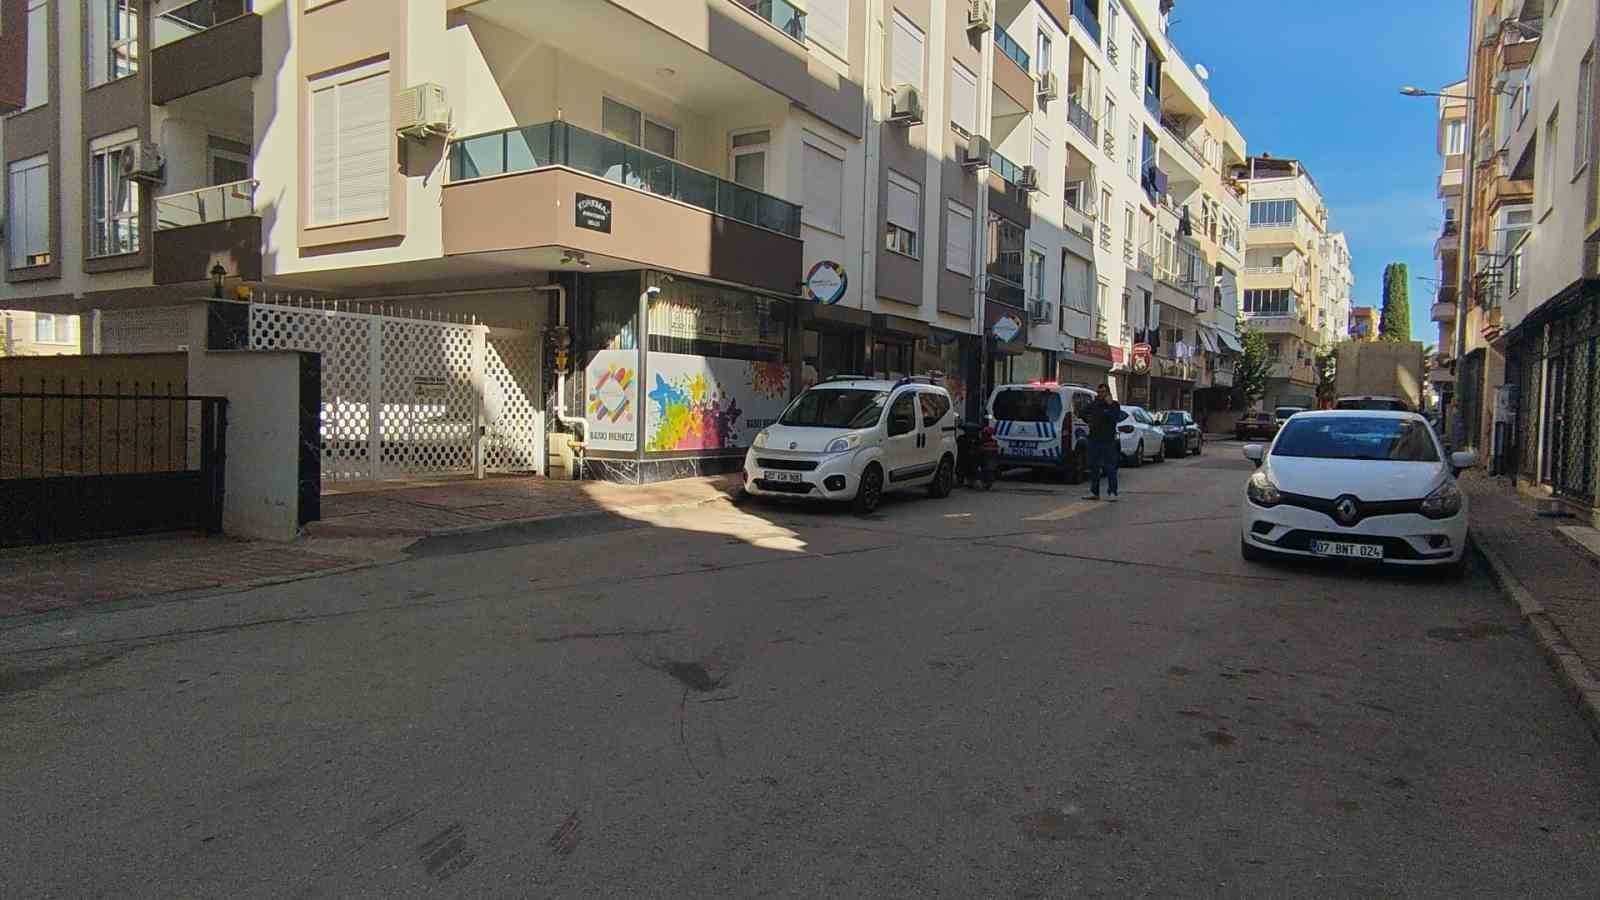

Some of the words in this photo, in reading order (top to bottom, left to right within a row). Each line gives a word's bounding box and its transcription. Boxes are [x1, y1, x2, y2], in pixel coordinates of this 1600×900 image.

[1317, 543, 1329, 553] 07
[1336, 543, 1354, 555] BNT
[1360, 545, 1381, 558] 024
